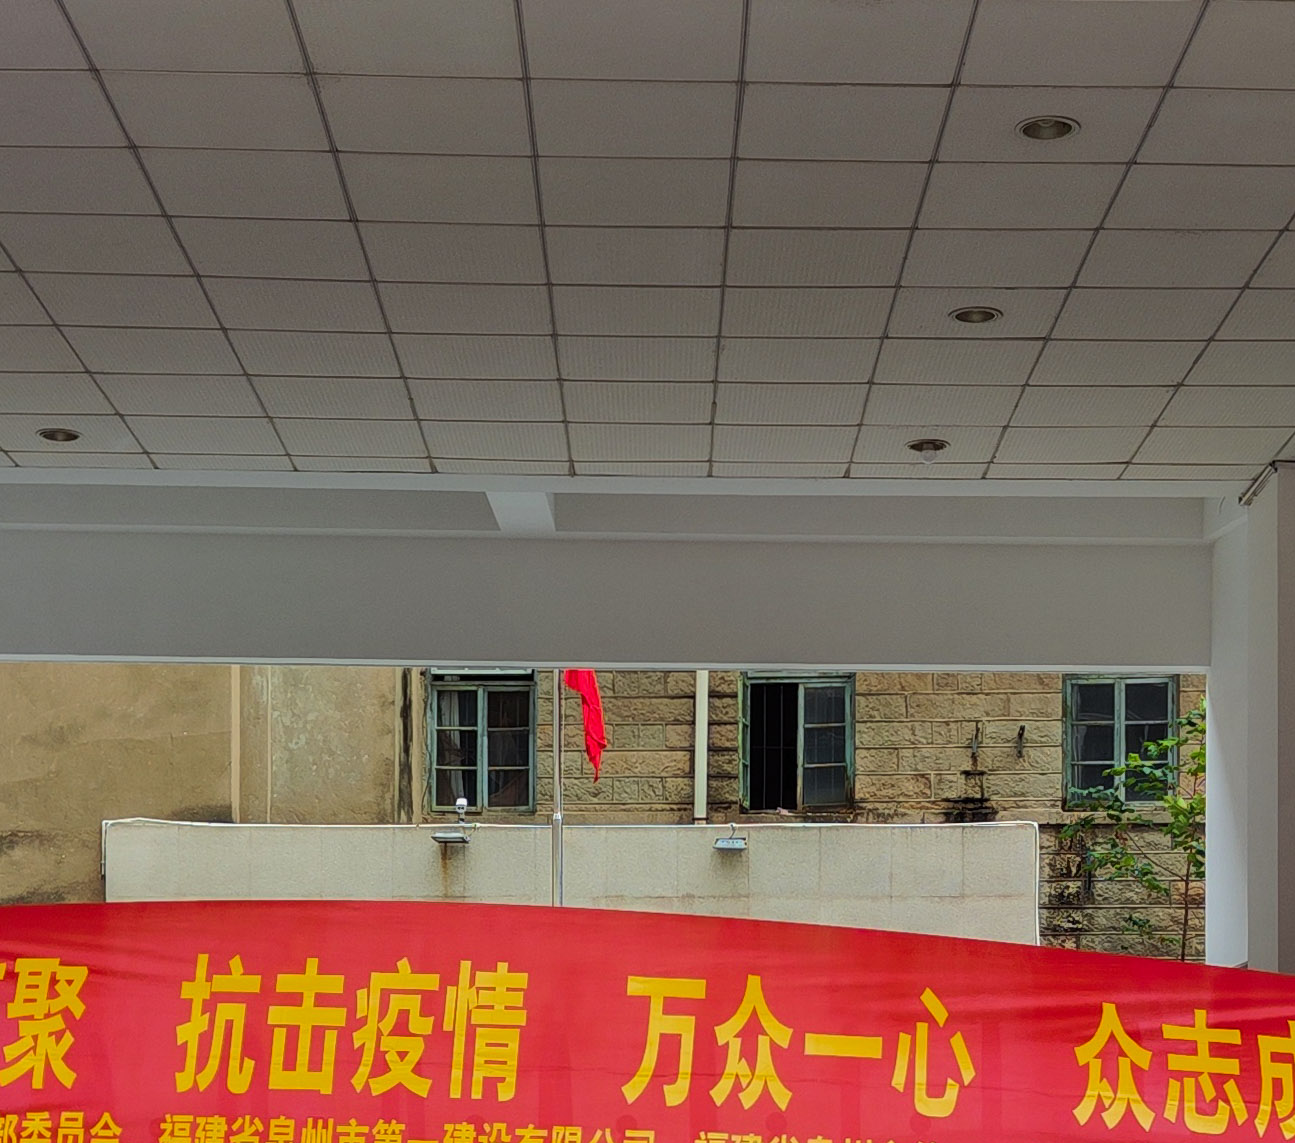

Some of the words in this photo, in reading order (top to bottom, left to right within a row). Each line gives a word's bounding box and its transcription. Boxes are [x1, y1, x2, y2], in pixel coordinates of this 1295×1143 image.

[175, 953, 529, 1103] 抗击疫情
[621, 974, 976, 1118] 万众一心
